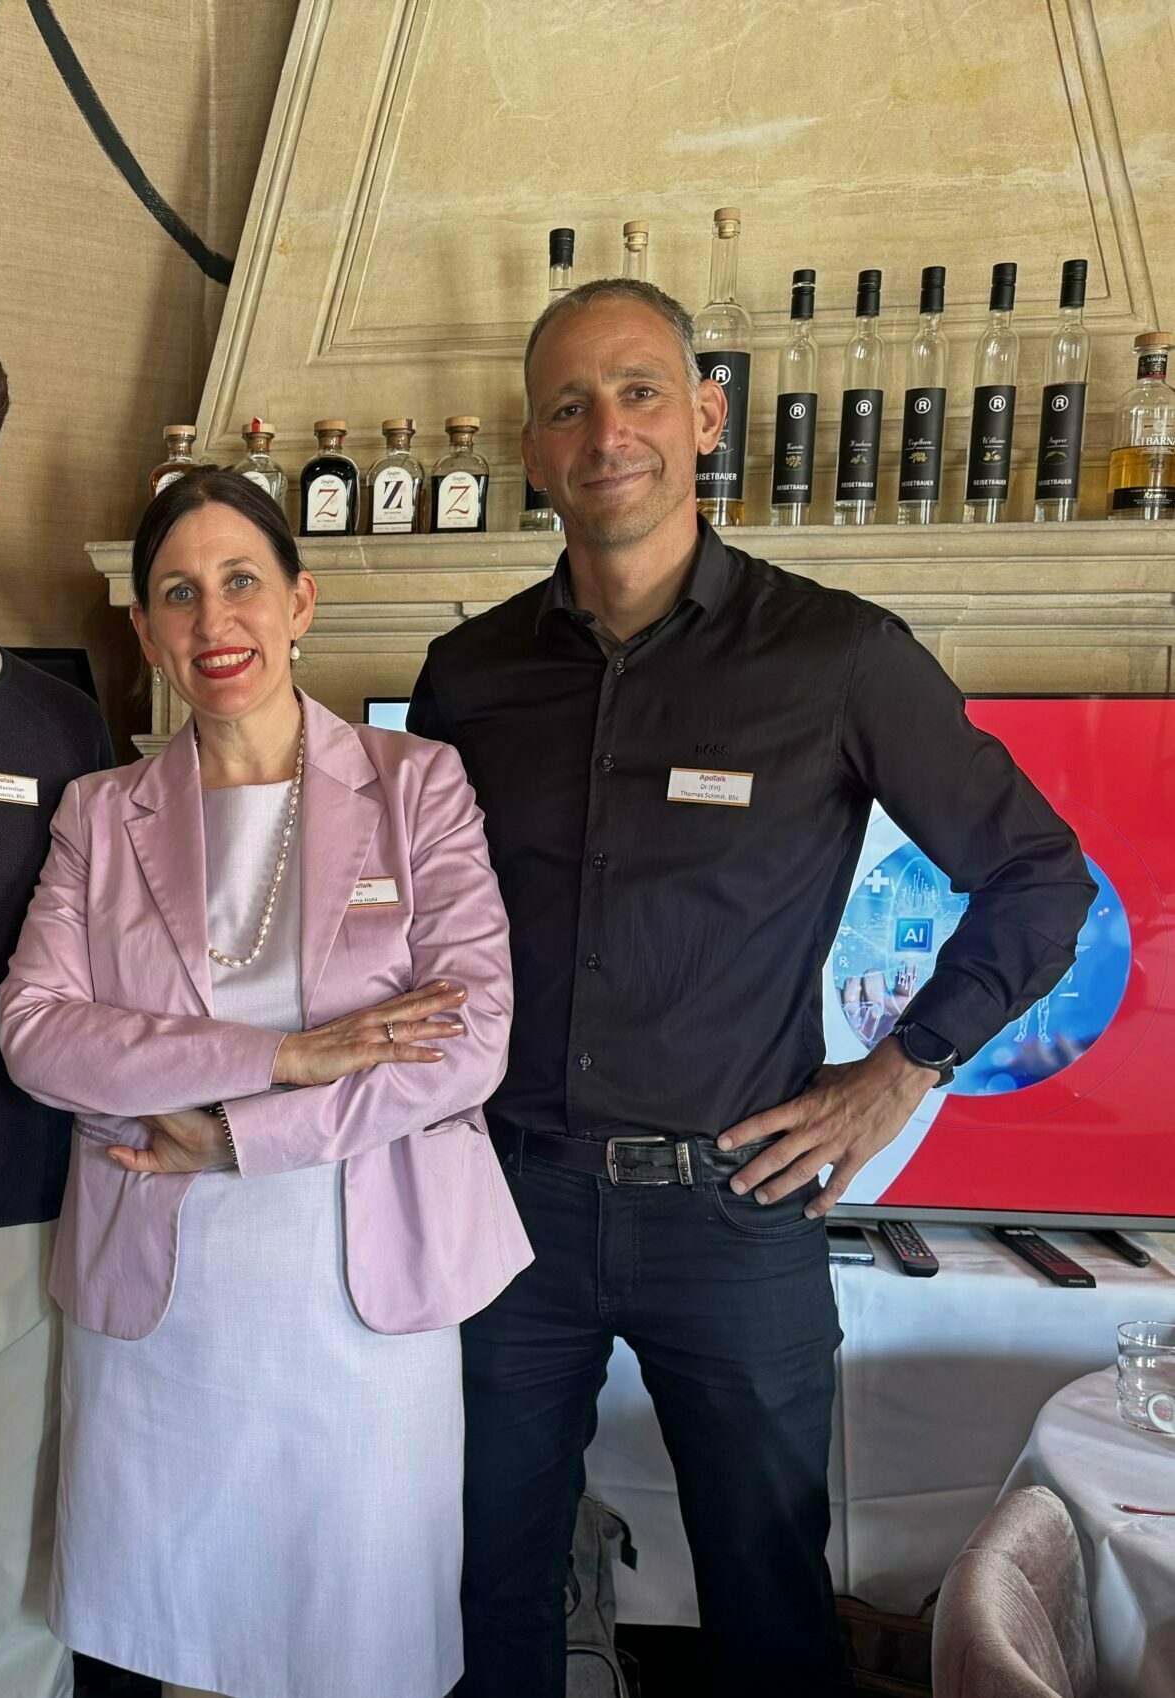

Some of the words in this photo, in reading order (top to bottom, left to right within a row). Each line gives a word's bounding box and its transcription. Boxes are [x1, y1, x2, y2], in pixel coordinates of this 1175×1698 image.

[695, 472, 737, 481] EISETBAUER
[315, 488, 339, 518] Z
[382, 480, 404, 510] Z
[445, 485, 471, 515] Z
[699, 774, 727, 783] ApoTalk
[680, 790, 704, 798] Thomas
[903, 927, 924, 943] AI
